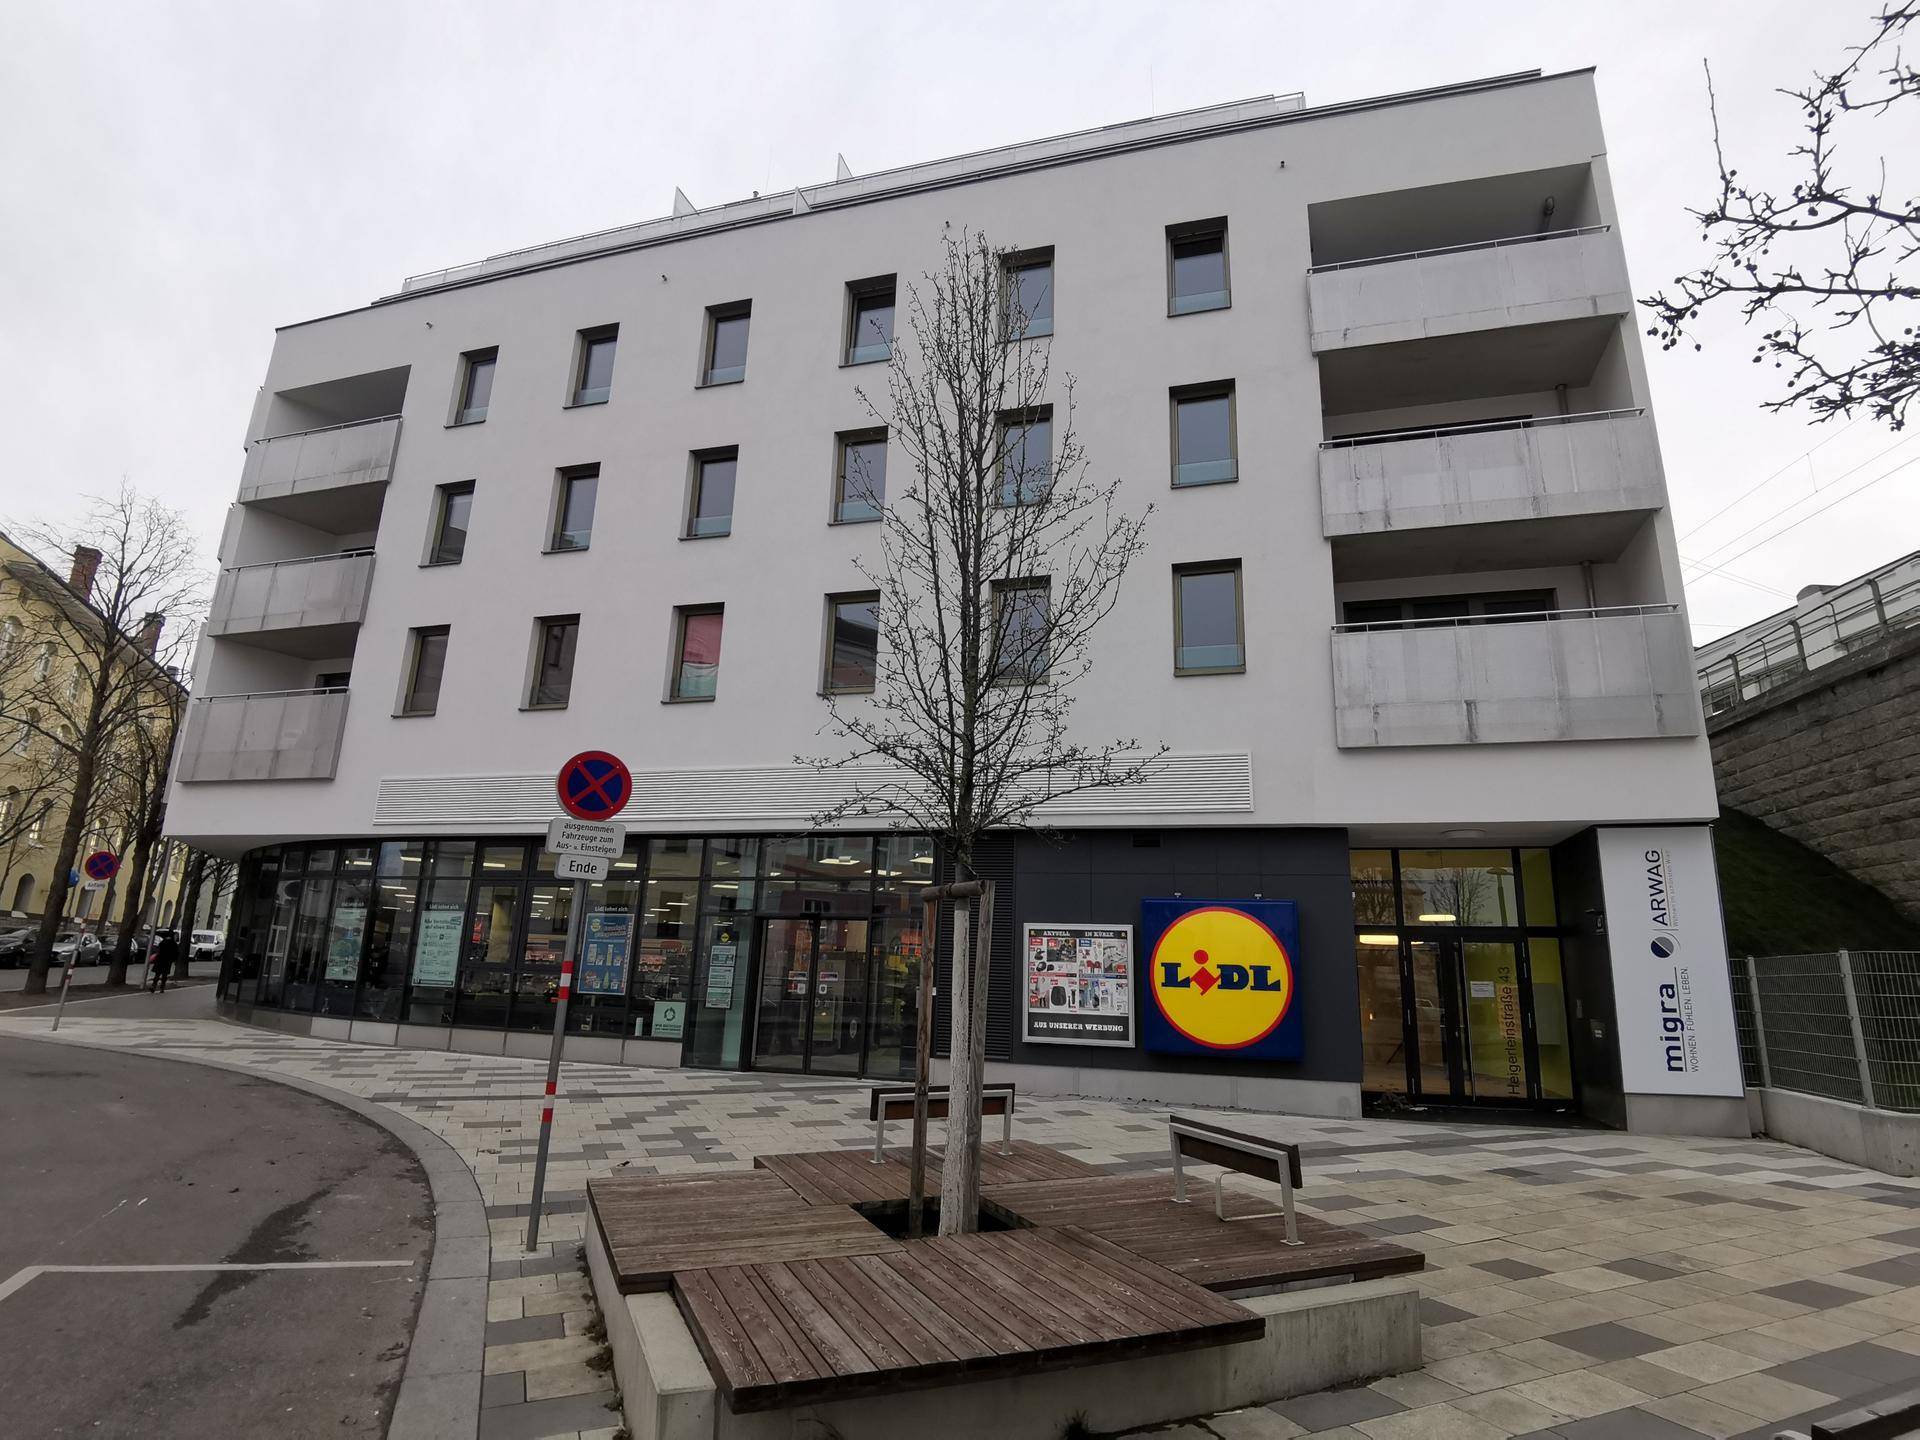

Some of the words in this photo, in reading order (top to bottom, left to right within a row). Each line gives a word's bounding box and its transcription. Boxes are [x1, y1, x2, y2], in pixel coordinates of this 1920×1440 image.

[564, 822, 615, 834] ausgenommen
[561, 831, 599, 843] Fahrzeuge
[599, 836, 614, 844] zum
[556, 841, 572, 850] Aus-
[580, 843, 617, 854] Einsteigen
[569, 860, 597, 874] Ende
[1645, 849, 1668, 926] ARWAG
[1497, 966, 1510, 983] 43
[1033, 1021, 1048, 1029] AUS
[1049, 1022, 1083, 1030] UNSERER
[1085, 1023, 1124, 1032] WERBUNG
[1659, 983, 1685, 1073] migra
[1501, 987, 1521, 1095] Heigerleinstraße
